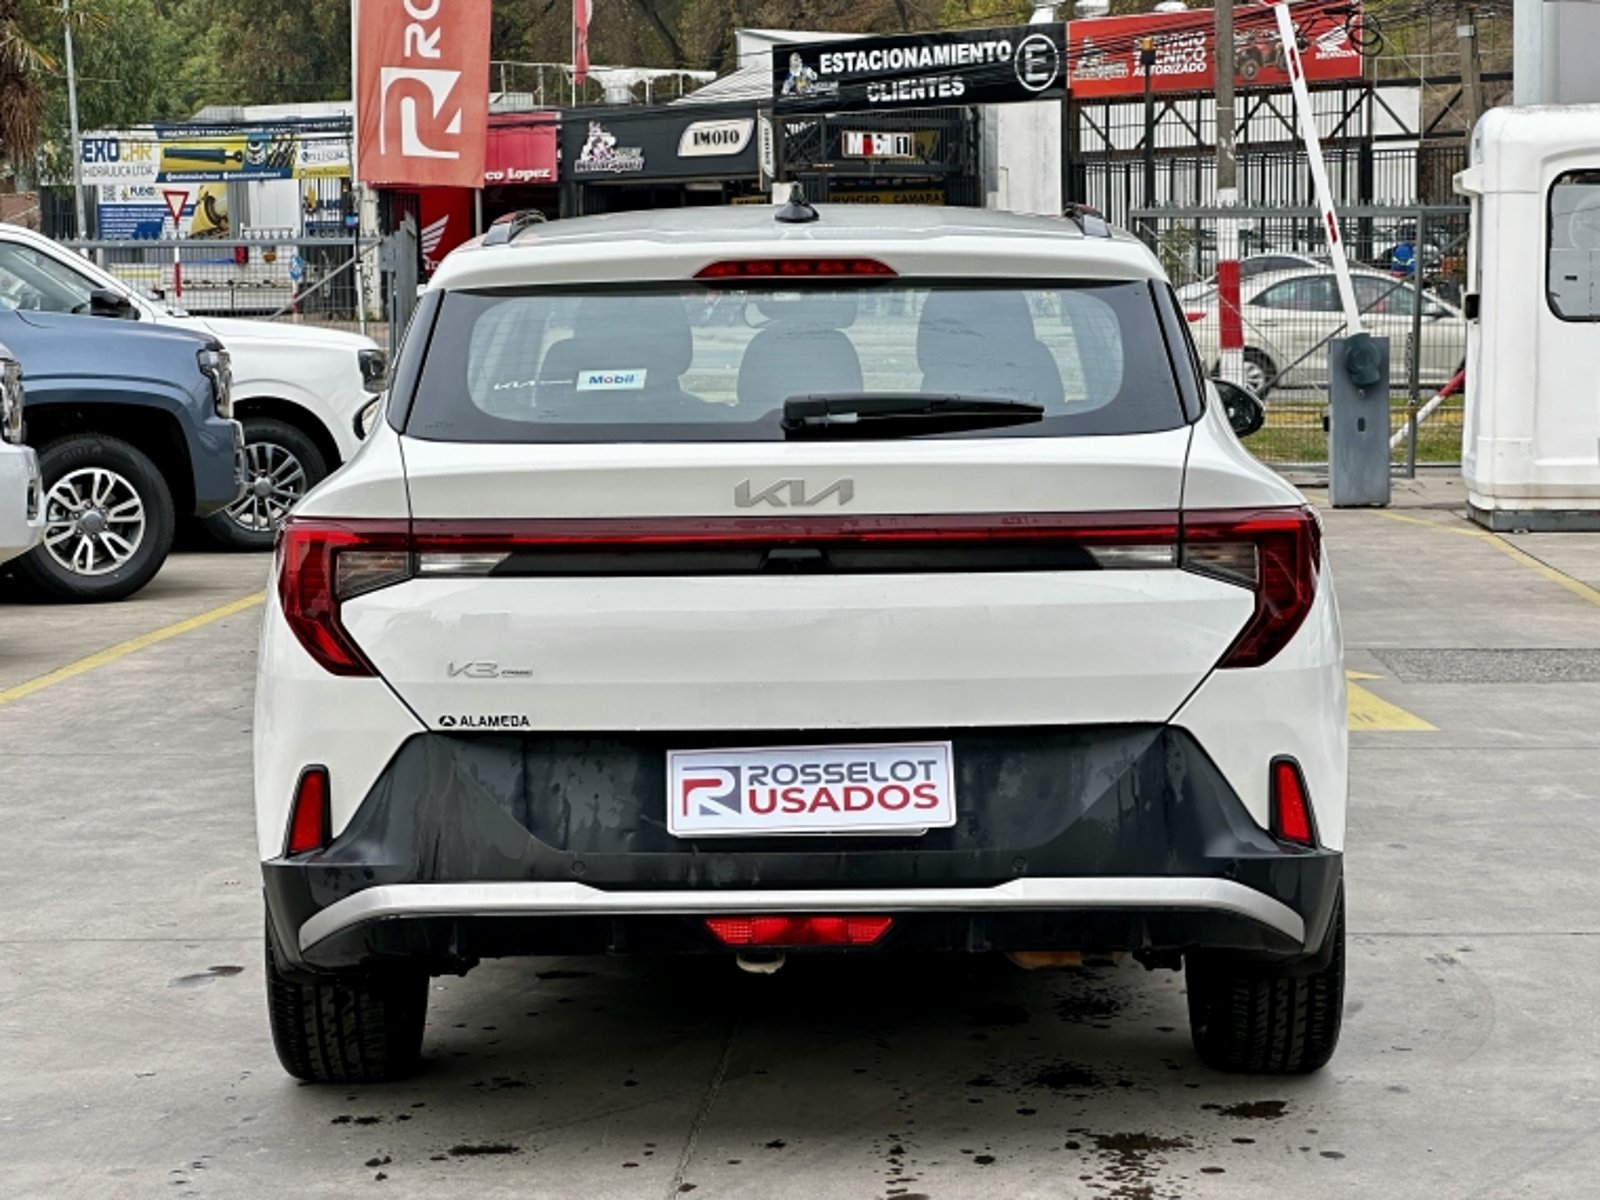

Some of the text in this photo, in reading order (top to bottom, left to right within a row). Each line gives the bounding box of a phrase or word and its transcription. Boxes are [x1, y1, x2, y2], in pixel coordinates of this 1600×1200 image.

[819, 40, 1012, 74] ESTACIONAMIENTO
[866, 75, 966, 102] CLIENTES
[693, 130, 740, 146] IMOTO
[507, 167, 551, 182] Lopez
[589, 374, 635, 385] Mobil
[447, 661, 500, 679] K3
[459, 715, 532, 727] ALAMEDA
[747, 759, 938, 786] ROSSELOT
[748, 782, 940, 816] USADOS
